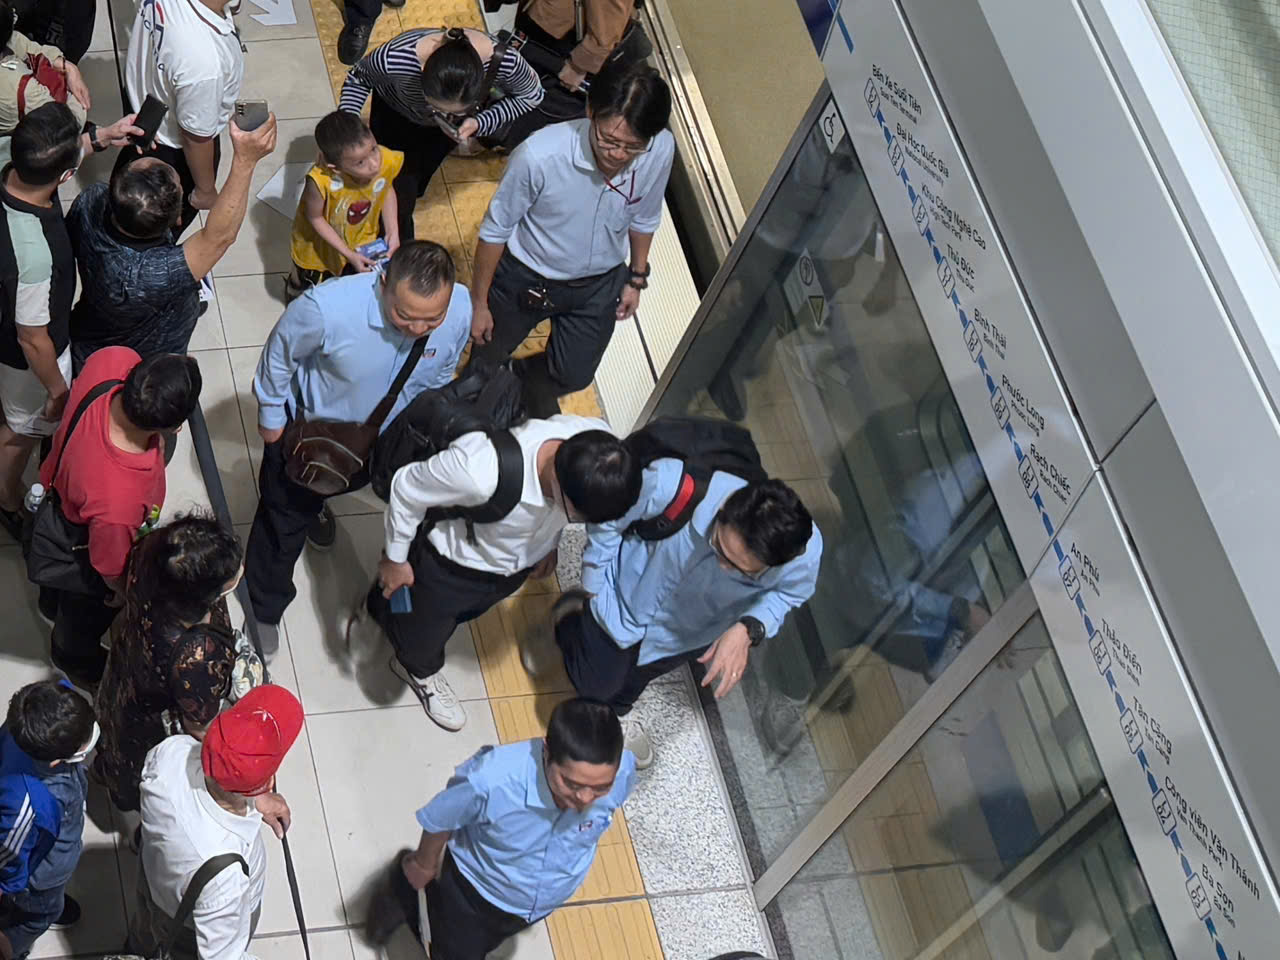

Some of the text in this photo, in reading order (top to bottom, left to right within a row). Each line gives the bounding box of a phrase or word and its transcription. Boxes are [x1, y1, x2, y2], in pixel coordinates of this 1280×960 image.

[947, 244, 975, 280] Thủ Đức
[974, 308, 1007, 350] Bình Thái
[1002, 374, 1045, 430] Phước Long
[1030, 443, 1071, 496] Rạch Chiếc
[1071, 542, 1100, 583] An Phú
[1102, 618, 1121, 651] Thảo
[1133, 696, 1172, 755] Tân Cảng
[1165, 776, 1187, 814] Công
[1210, 828, 1228, 861] Văn
[1230, 853, 1260, 900] Thánh
[1202, 863, 1234, 913] Ba Son
